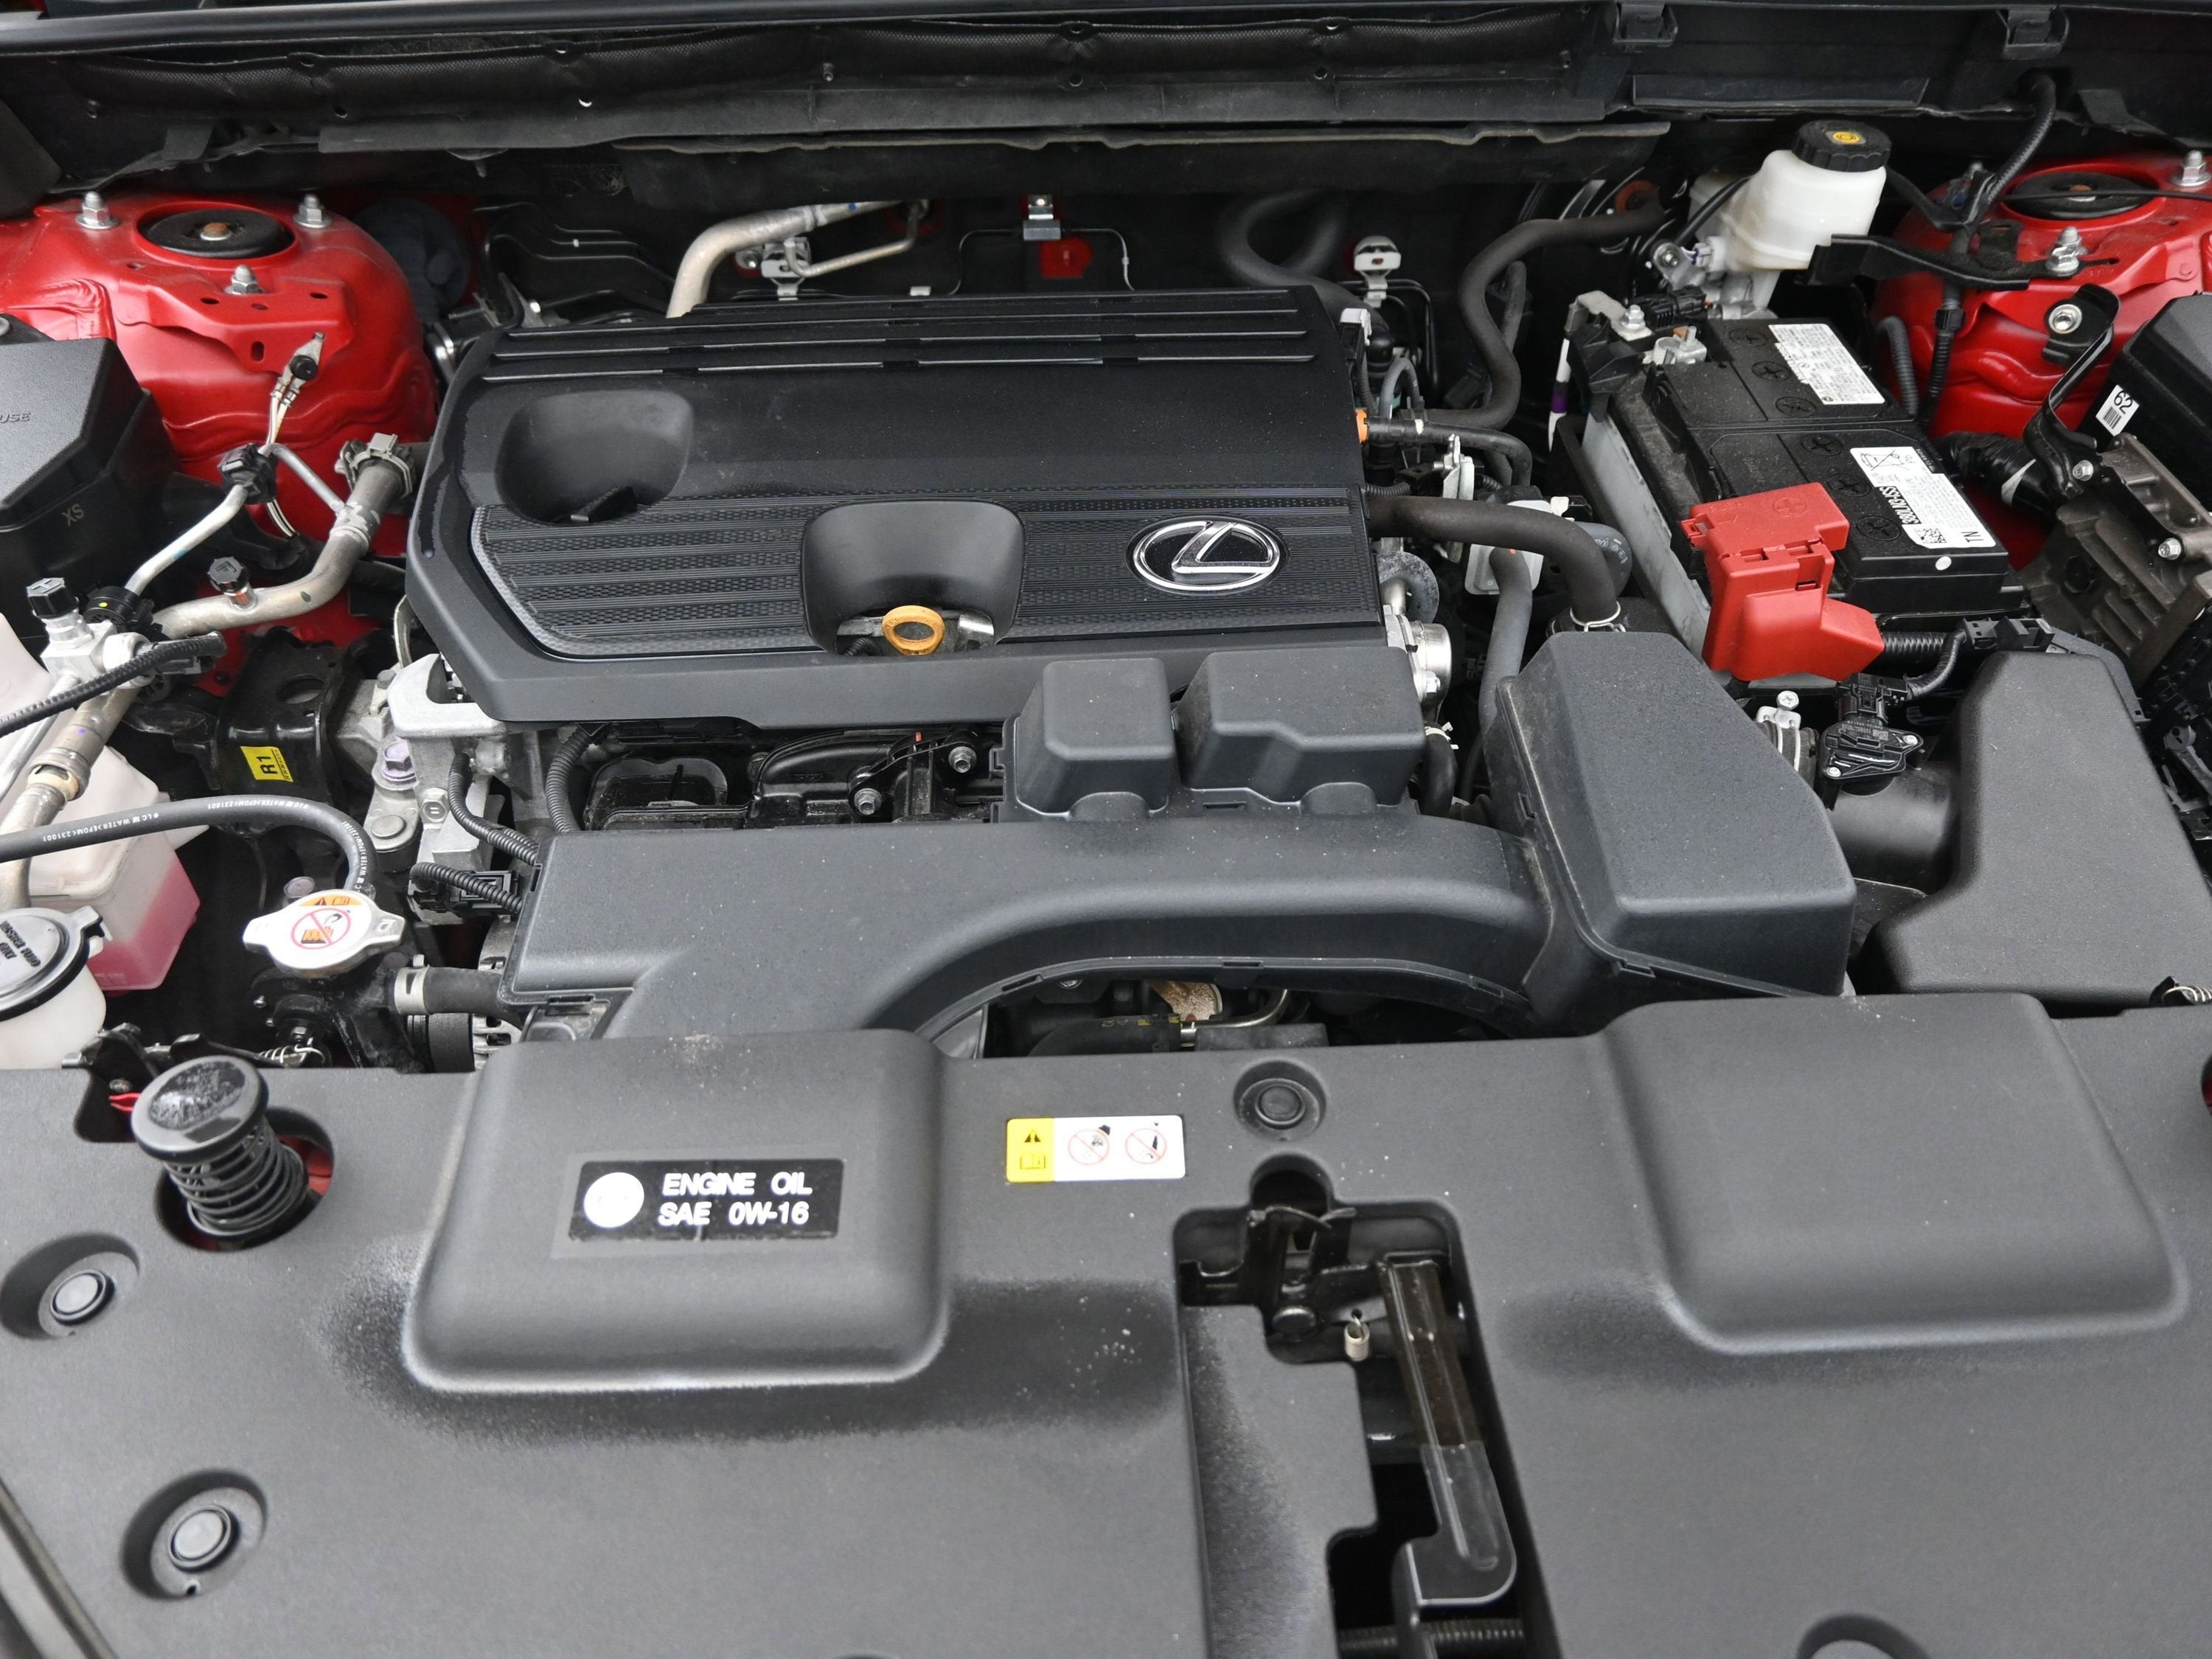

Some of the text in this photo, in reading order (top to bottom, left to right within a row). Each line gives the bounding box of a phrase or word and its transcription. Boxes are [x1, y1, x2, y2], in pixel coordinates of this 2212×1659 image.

[2114, 390, 2133, 414] 62
[61, 503, 84, 526] XS
[1879, 487, 1920, 524] 380LN3-ISS
[1961, 532, 1983, 543] TN
[256, 756, 278, 774] R1
[662, 1172, 813, 1195] ENGINE OIL
[658, 1201, 810, 1226] SAE 0W-16
